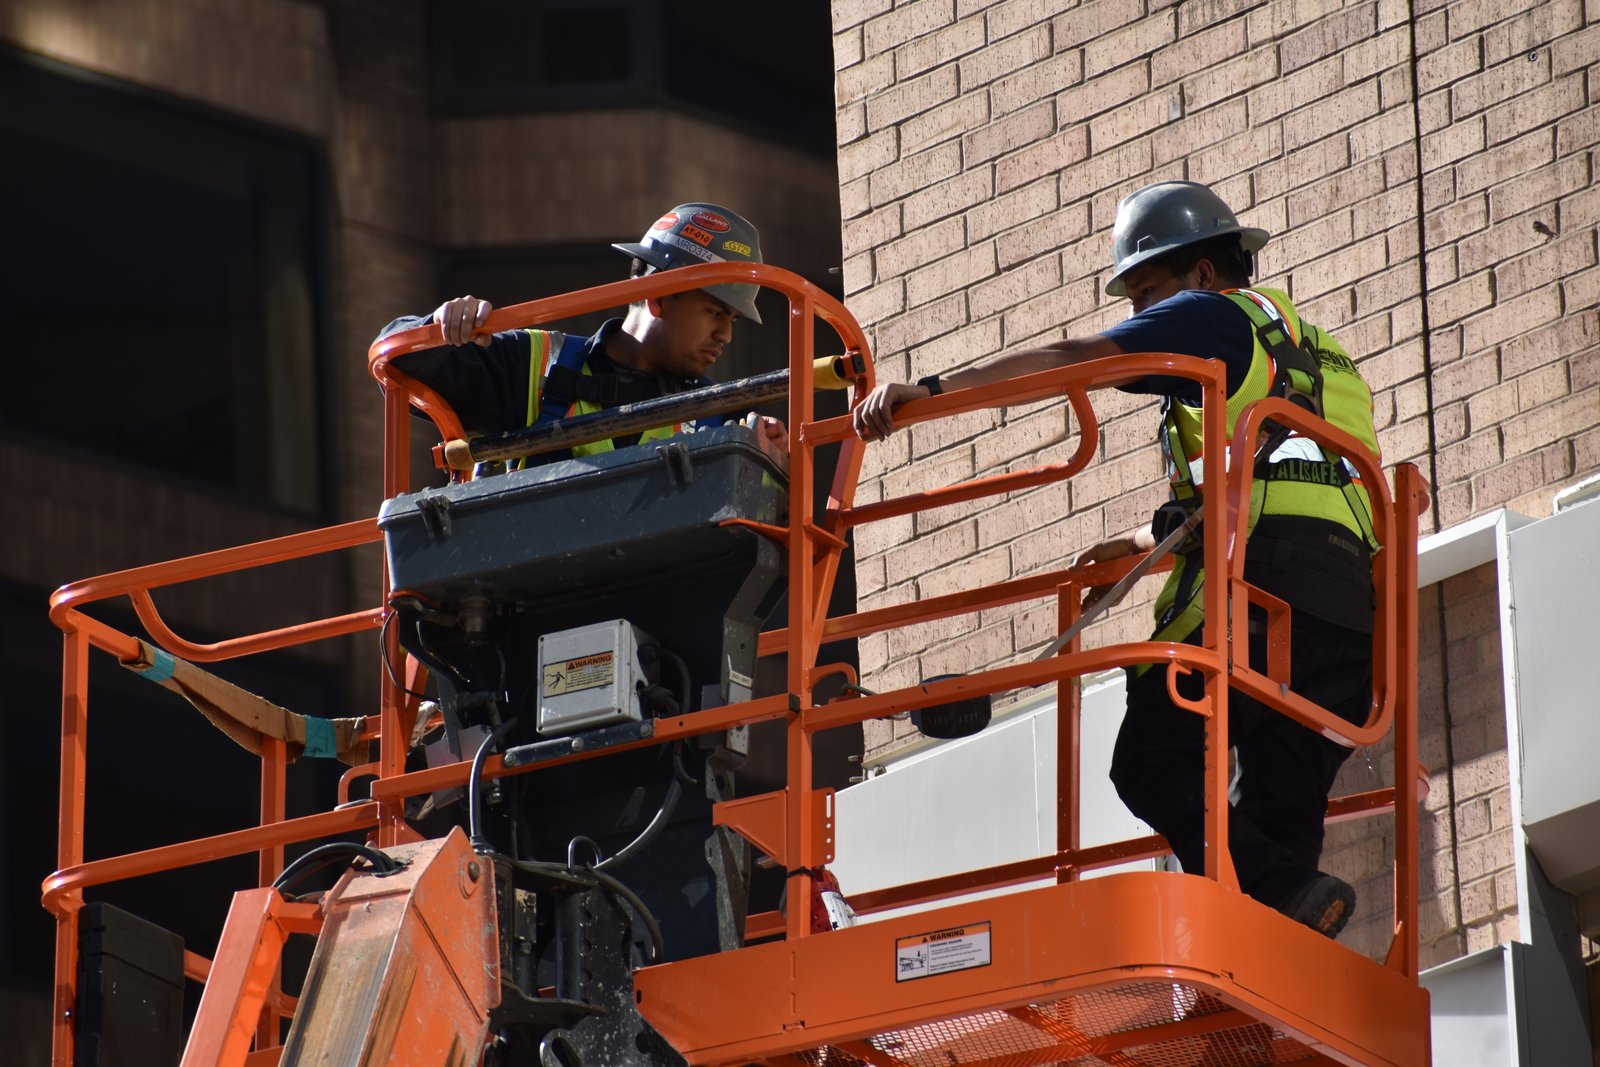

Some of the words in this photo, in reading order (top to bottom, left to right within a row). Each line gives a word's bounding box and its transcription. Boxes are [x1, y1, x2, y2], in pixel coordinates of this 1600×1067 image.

[684, 226, 710, 243] AT-010
[576, 655, 611, 668] WARNING
[930, 929, 965, 942] WARNING
